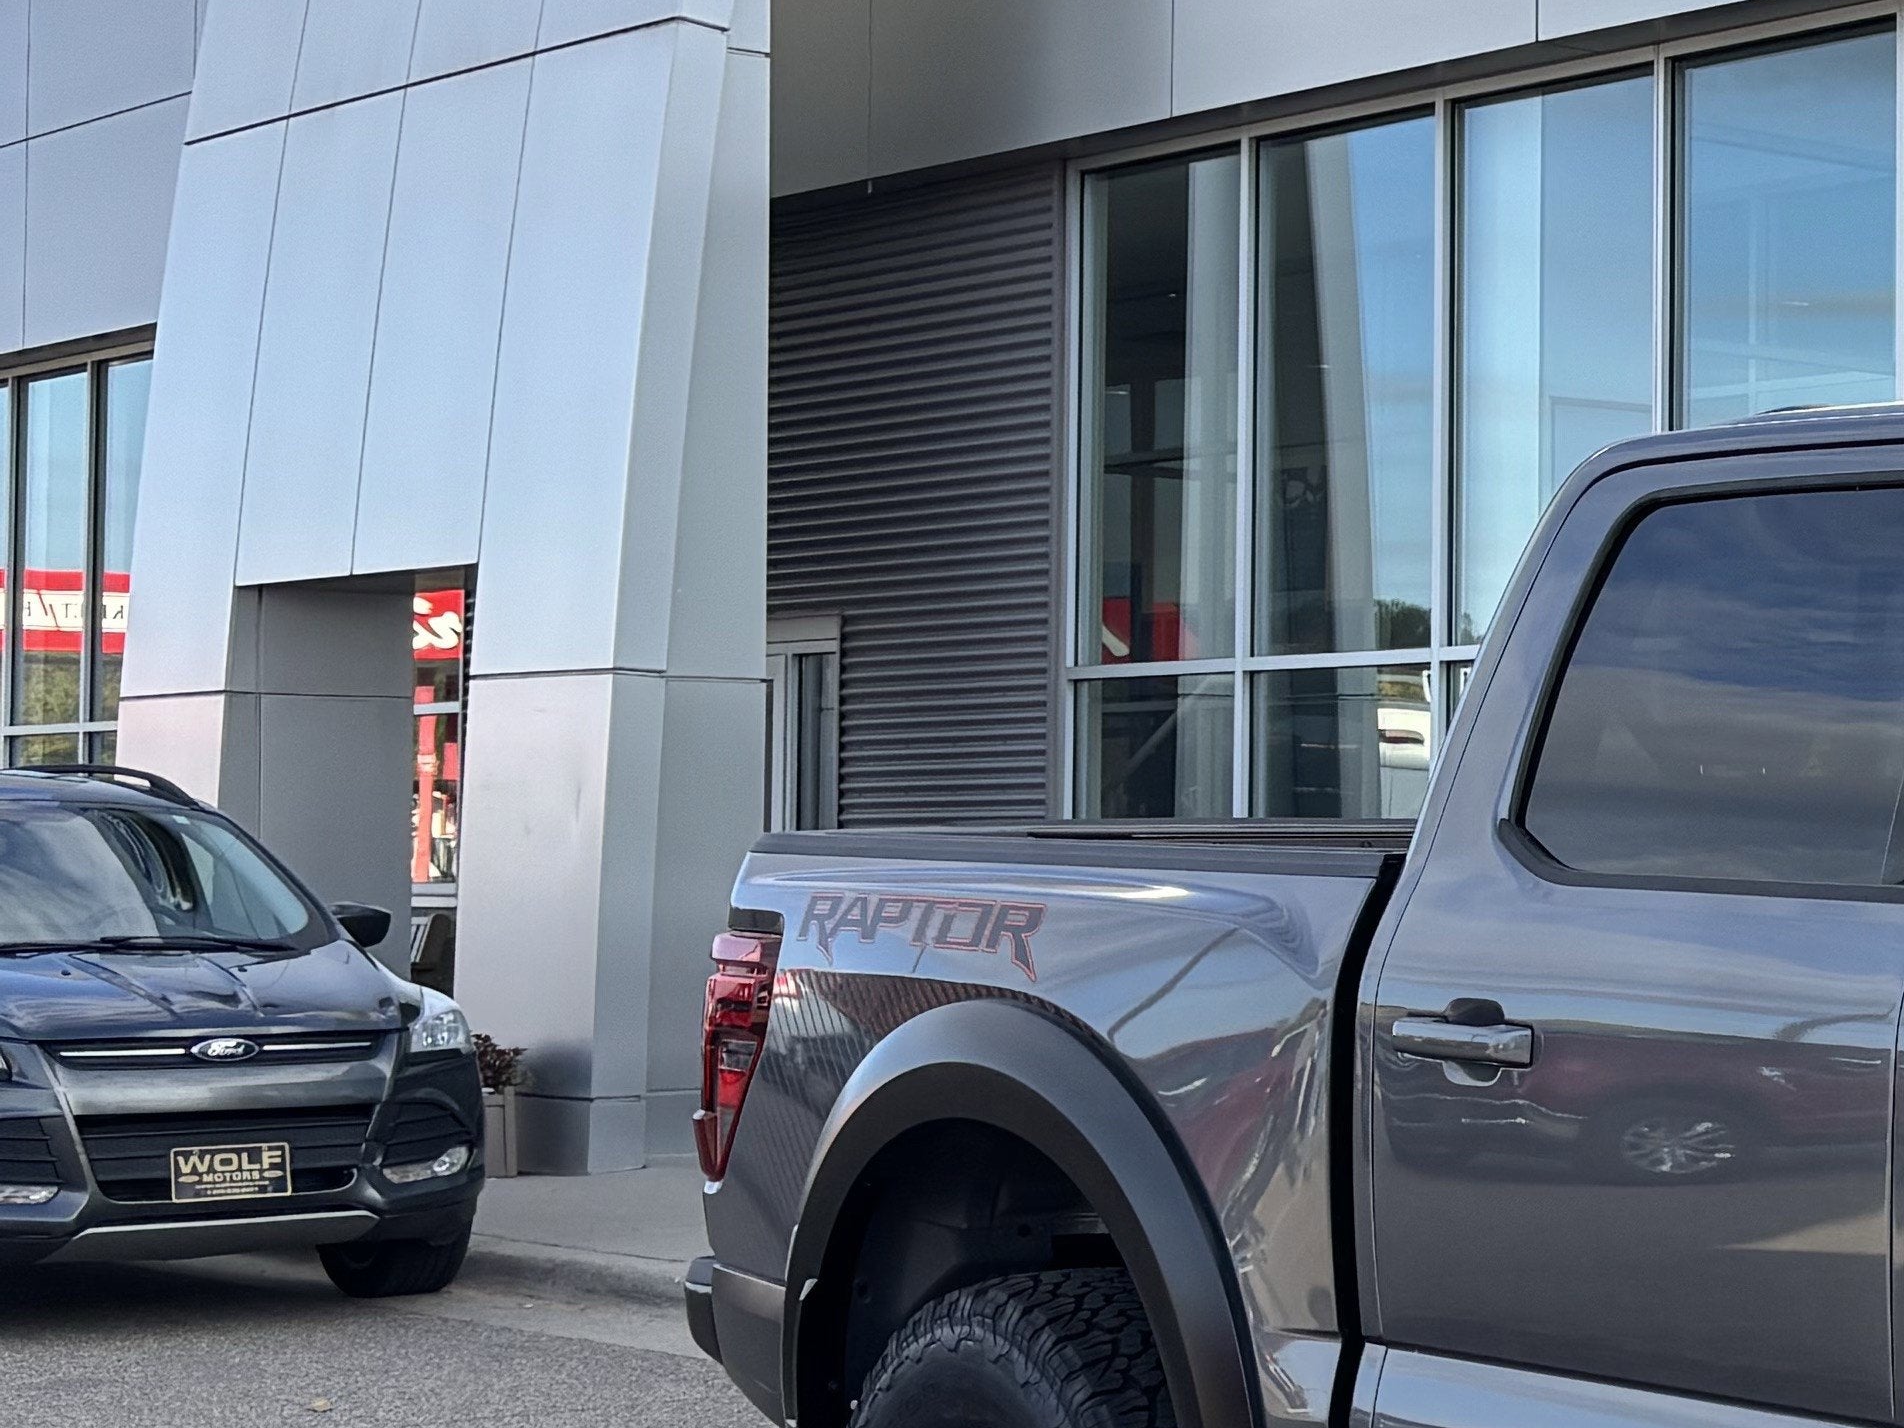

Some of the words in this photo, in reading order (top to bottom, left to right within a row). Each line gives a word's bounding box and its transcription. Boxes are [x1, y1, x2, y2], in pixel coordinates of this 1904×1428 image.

[797, 892, 1047, 982] RAPTOR
[177, 1151, 282, 1174] WOLF
[202, 1170, 260, 1183] MOTORS
